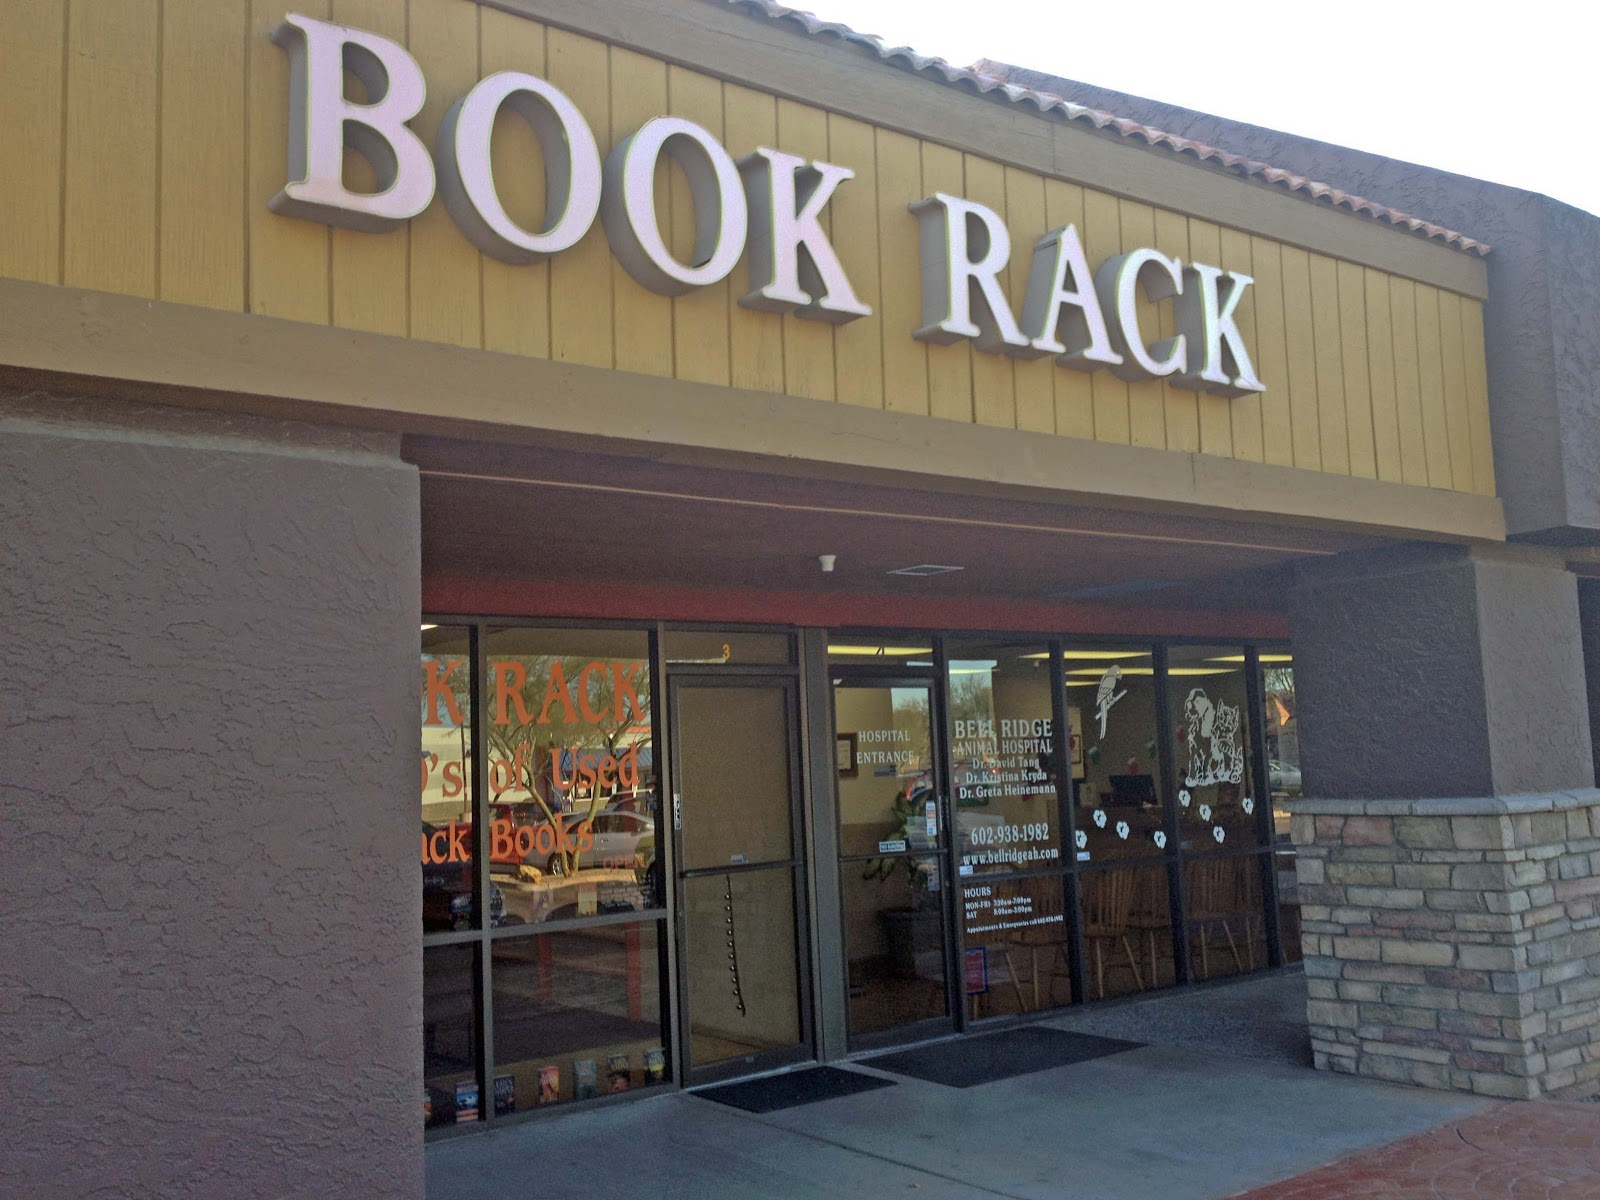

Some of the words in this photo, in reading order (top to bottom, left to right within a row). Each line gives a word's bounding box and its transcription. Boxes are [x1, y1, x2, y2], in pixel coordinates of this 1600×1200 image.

[284, 13, 873, 317] BOOK
[934, 191, 1267, 392] RACK
[722, 643, 731, 661] 3
[421, 660, 465, 725] K
[491, 660, 648, 725] RACK
[858, 730, 911, 742] HOSPITAL
[954, 719, 997, 739] BELL
[1001, 718, 1053, 738] RIDGE
[957, 741, 1000, 756] ANIMAL
[1002, 738, 1053, 754] HOSPITAL
[856, 750, 914, 764] ENTRANCE
[972, 757, 987, 769] Dr.
[989, 756, 1016, 768] David
[1018, 756, 1040, 769] Tang
[421, 753, 463, 797] 's
[489, 743, 531, 794] of
[549, 741, 641, 790] Used
[965, 771, 980, 784] Dr.
[982, 770, 1019, 783] Kristina
[1021, 769, 1047, 783] Kryda
[959, 787, 974, 799] Dr.
[976, 785, 1002, 798] Greta
[1004, 784, 1056, 796] Heinemann
[489, 812, 594, 859] Books
[971, 822, 1049, 846] 602-938-1982
[962, 846, 1059, 866] www.bellridgeah.com
[964, 886, 991, 898] HOURS
[965, 900, 991, 910] MON-FRI
